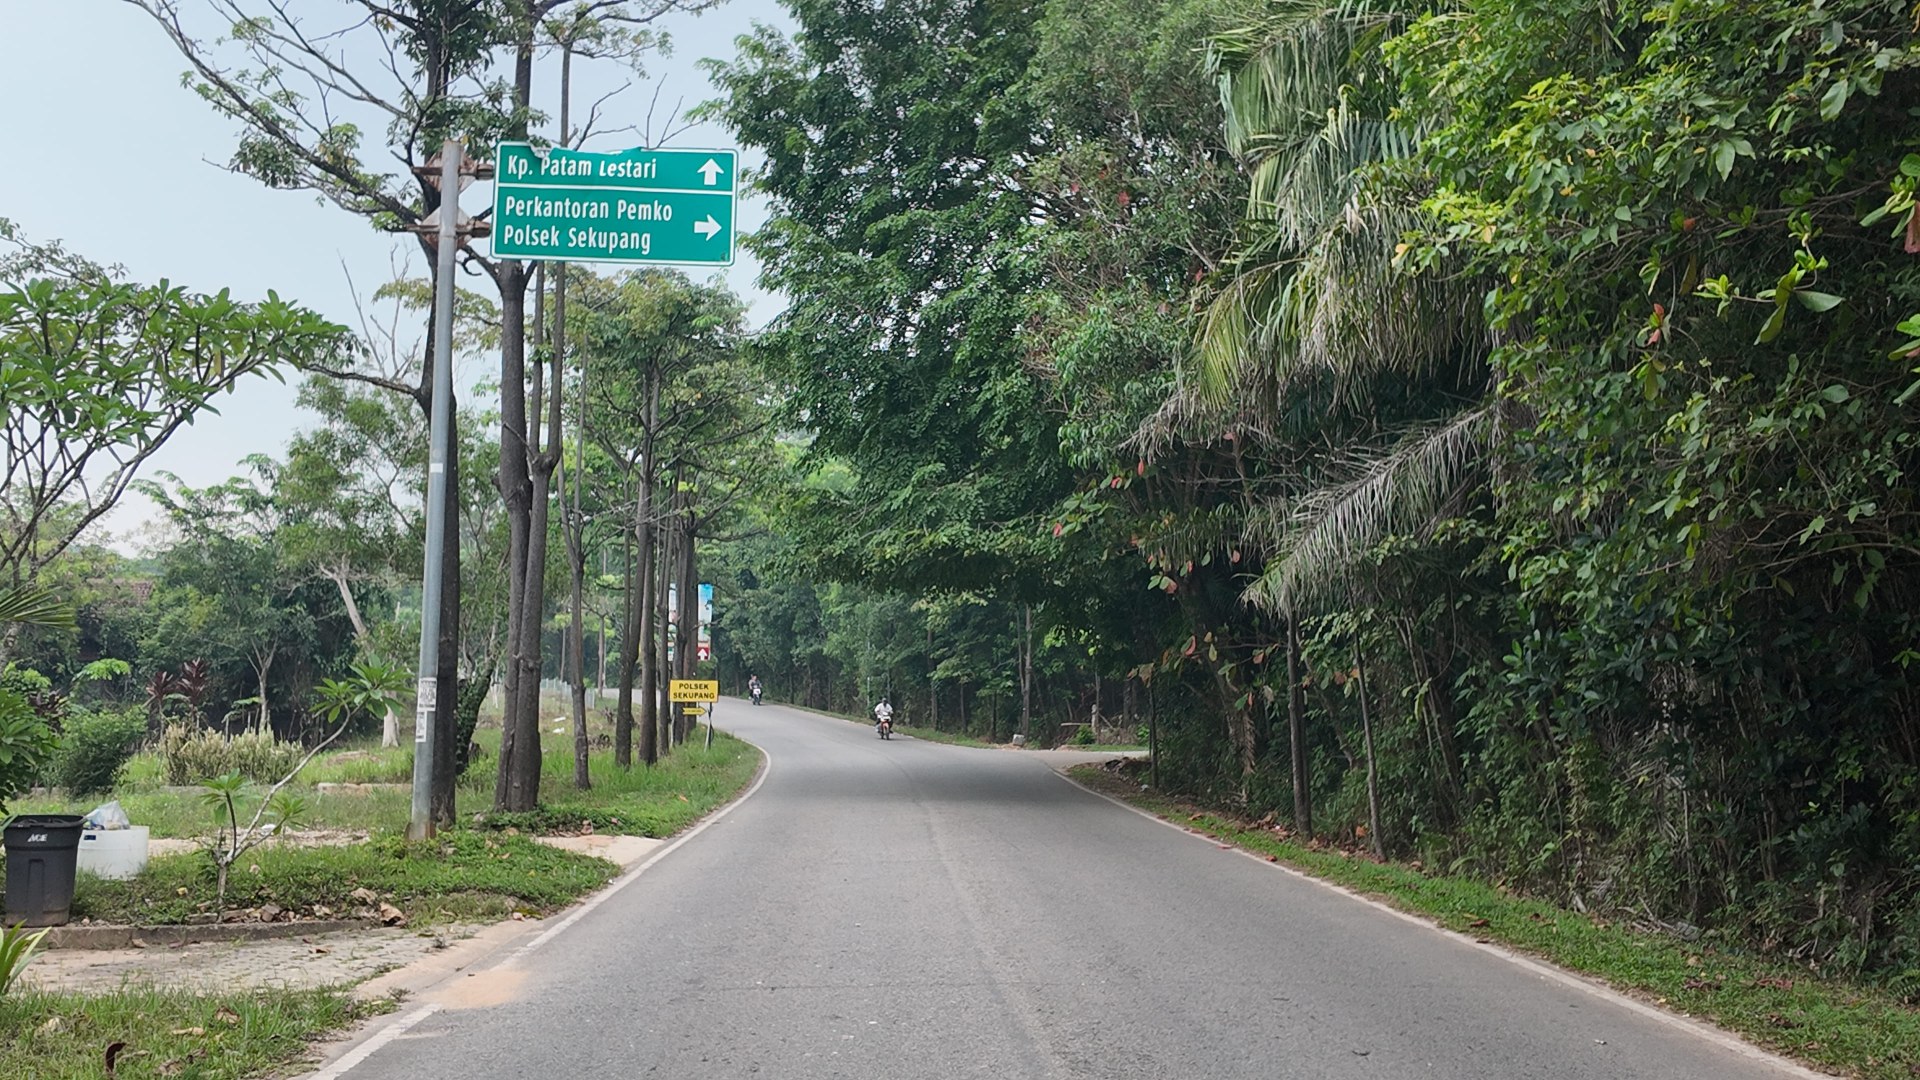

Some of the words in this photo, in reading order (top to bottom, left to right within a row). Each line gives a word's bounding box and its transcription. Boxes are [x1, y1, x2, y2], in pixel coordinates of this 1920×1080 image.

[507, 155, 533, 180] Kp.
[540, 156, 592, 177] Patam
[599, 158, 657, 179] Lestari
[505, 195, 609, 219] Perkantoran
[617, 199, 673, 222] Pemko
[503, 224, 560, 247] Polsek
[567, 226, 651, 255] Sekupang
[27, 833, 48, 842] ACE
